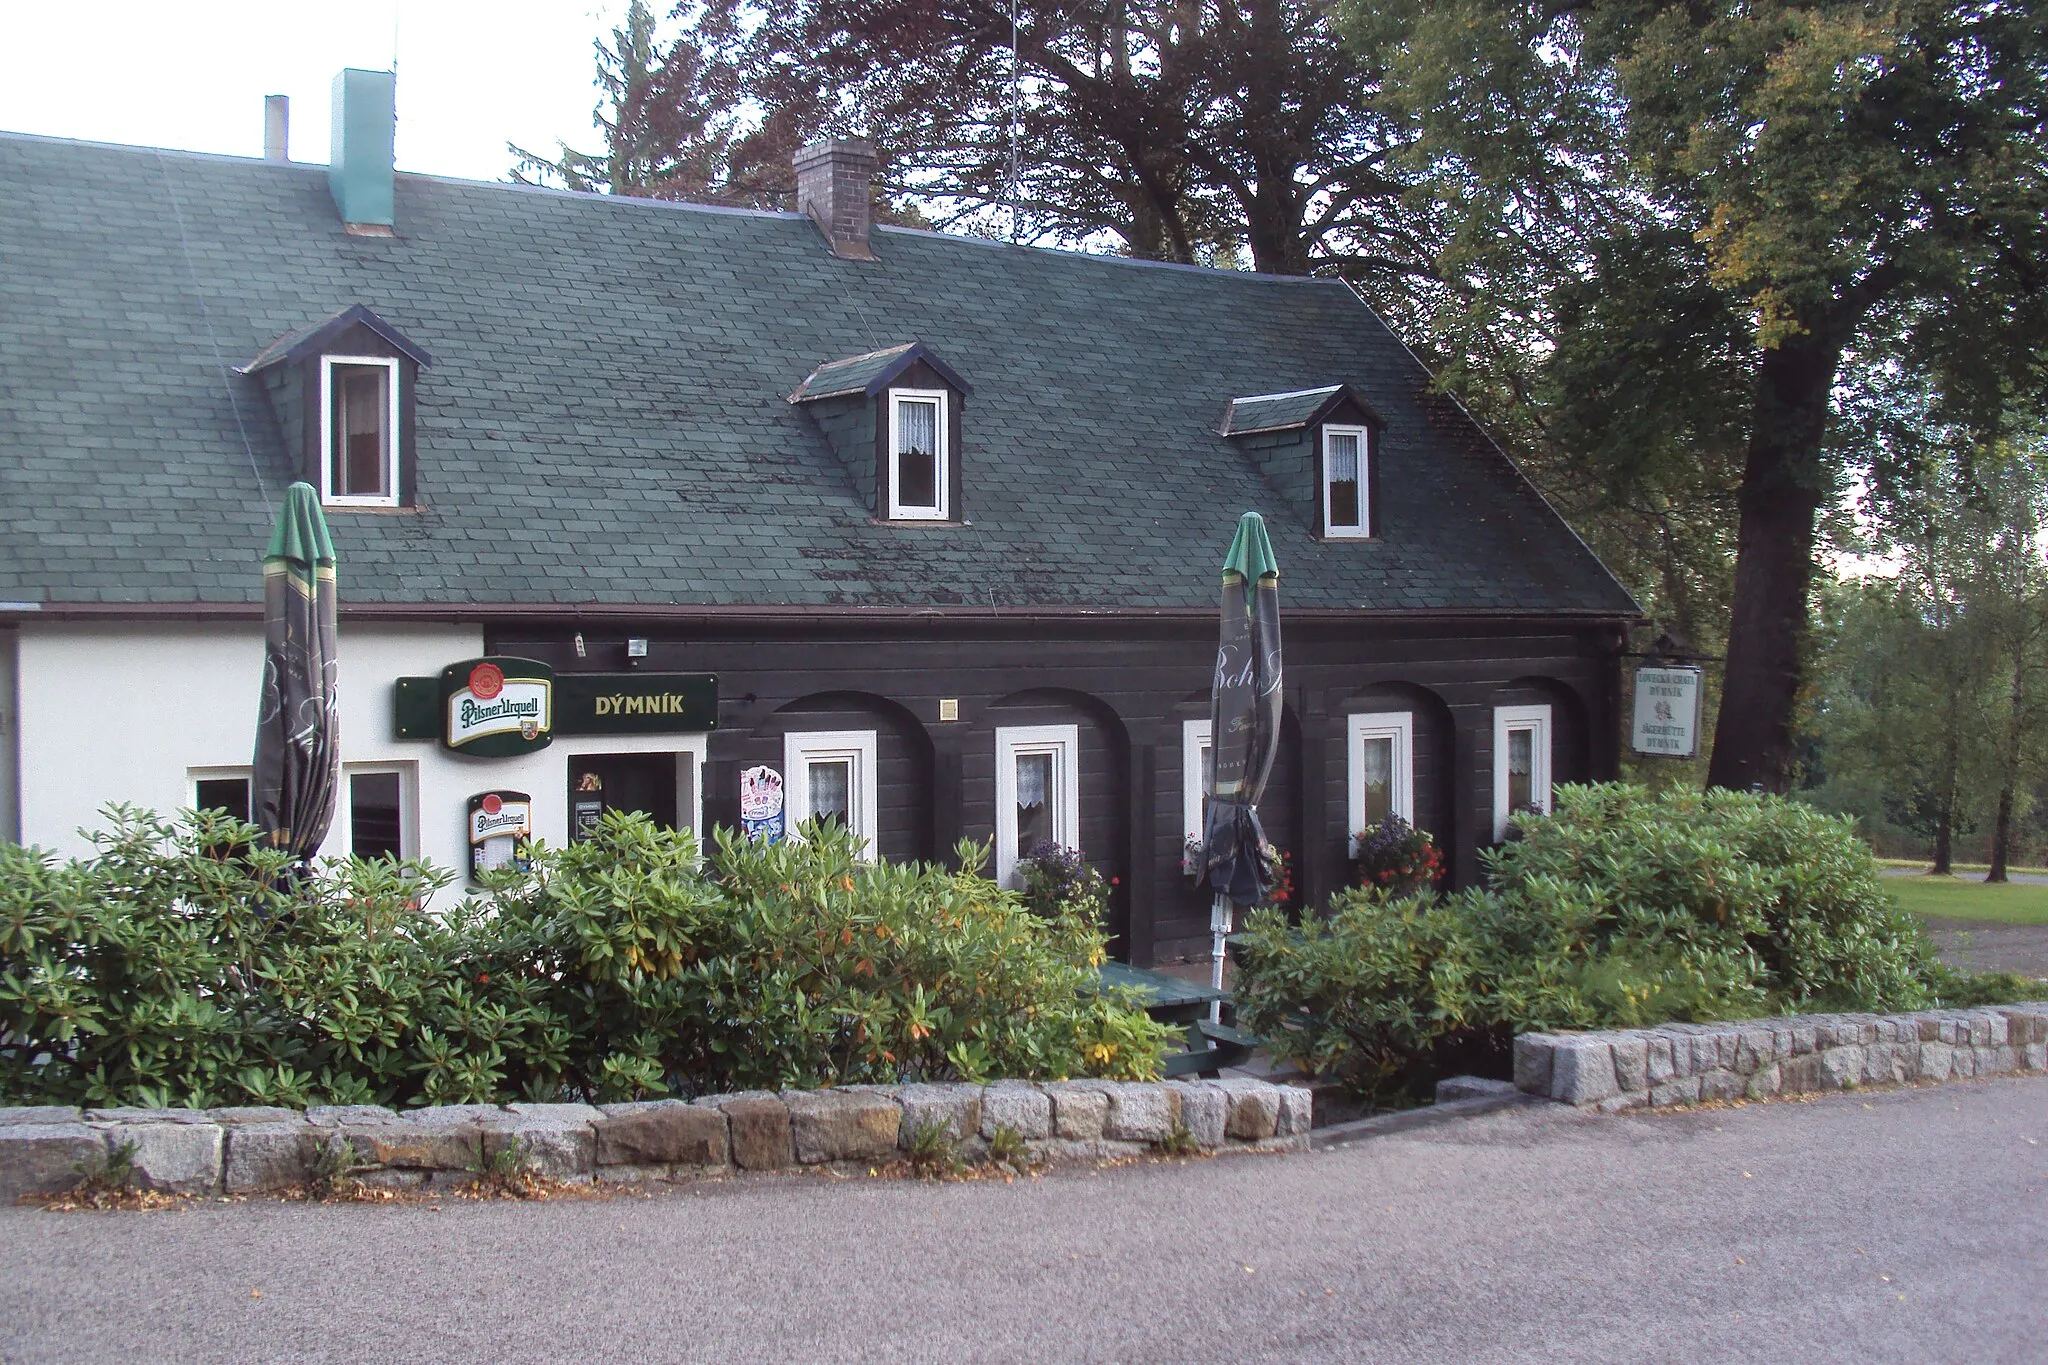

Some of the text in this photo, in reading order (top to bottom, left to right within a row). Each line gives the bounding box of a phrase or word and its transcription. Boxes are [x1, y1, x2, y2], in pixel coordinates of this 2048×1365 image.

[1213, 645, 1255, 690] Boh
[461, 697, 538, 729] Pilsner Urquell
[595, 692, 684, 715] DÝMNÍK
[477, 813, 525, 833] Pilsner Urquell
